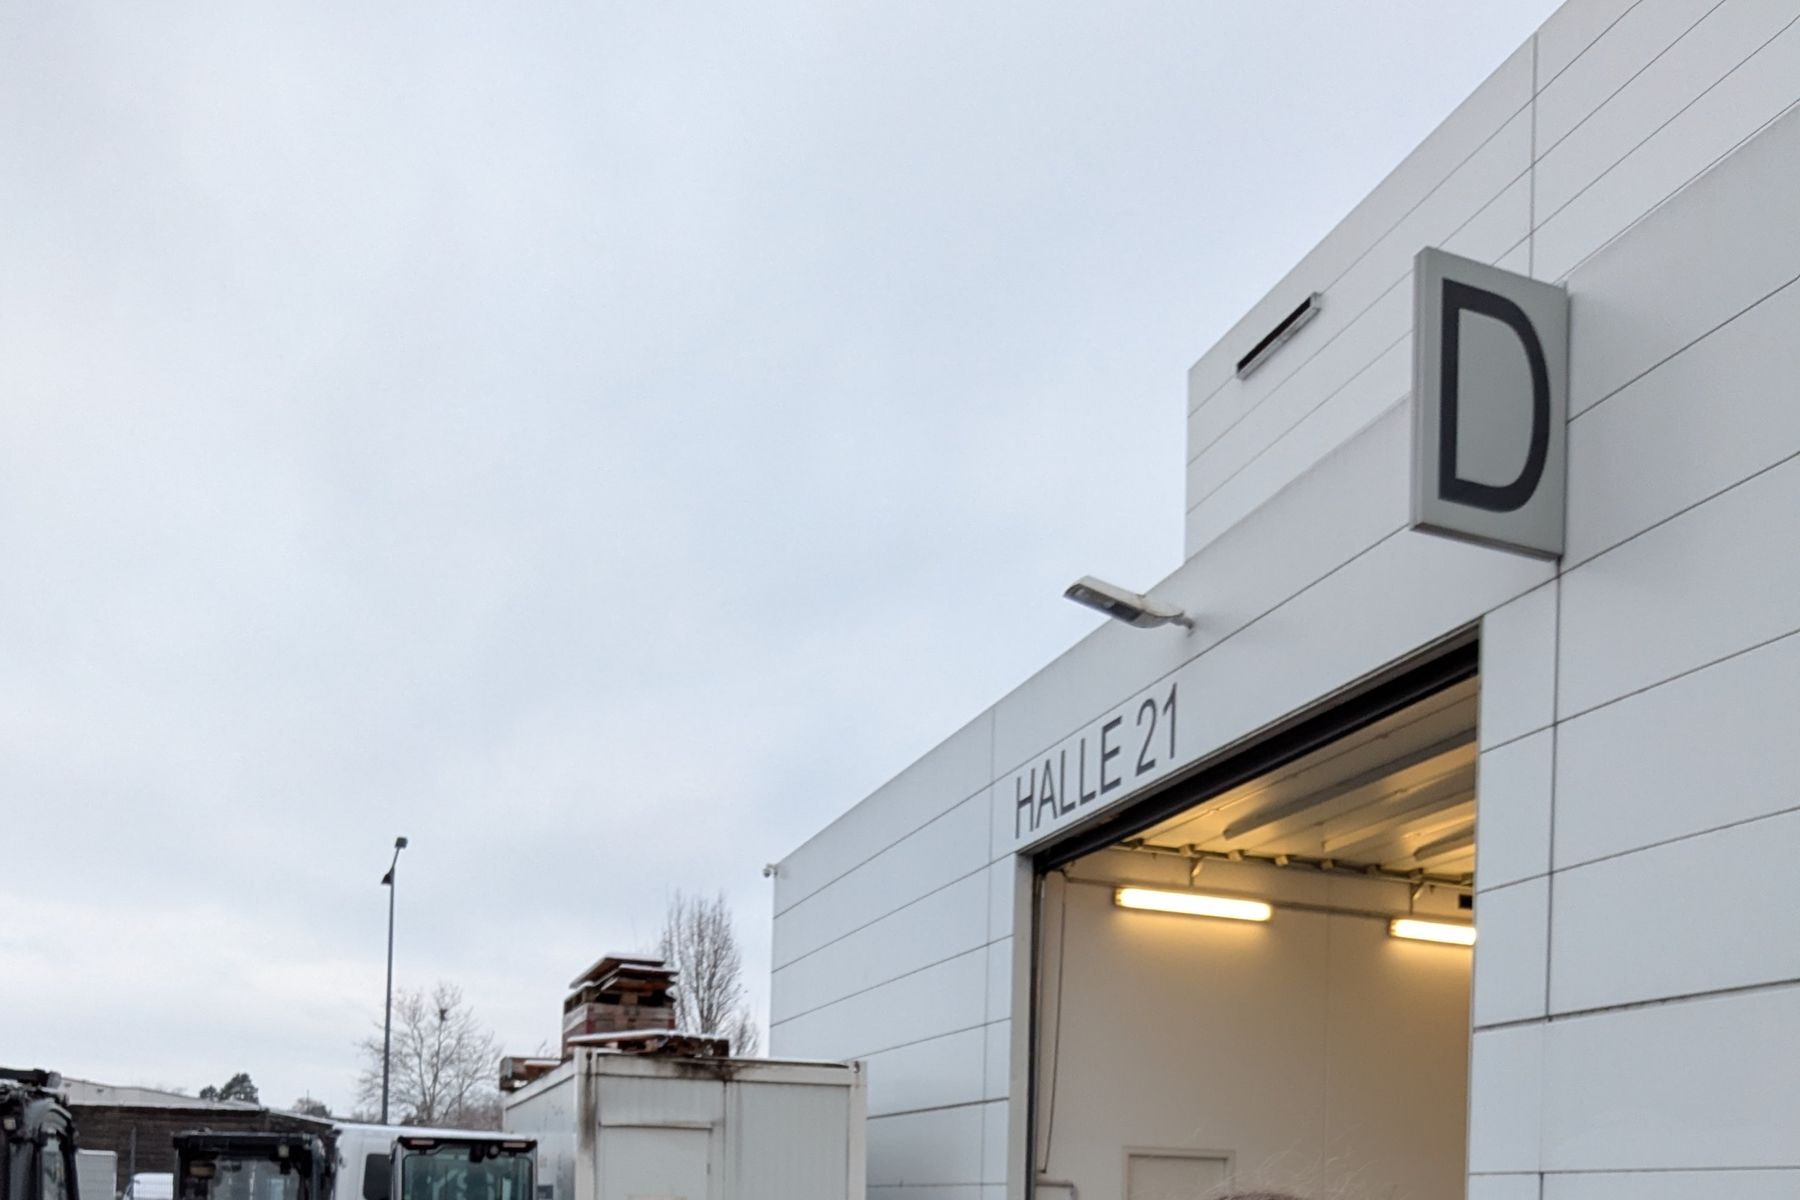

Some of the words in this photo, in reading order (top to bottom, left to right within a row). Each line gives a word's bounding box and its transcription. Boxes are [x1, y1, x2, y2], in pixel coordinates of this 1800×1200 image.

[1438, 278, 1550, 513] D
[1015, 715, 1123, 840] HALLE
[1135, 682, 1179, 778] 21
